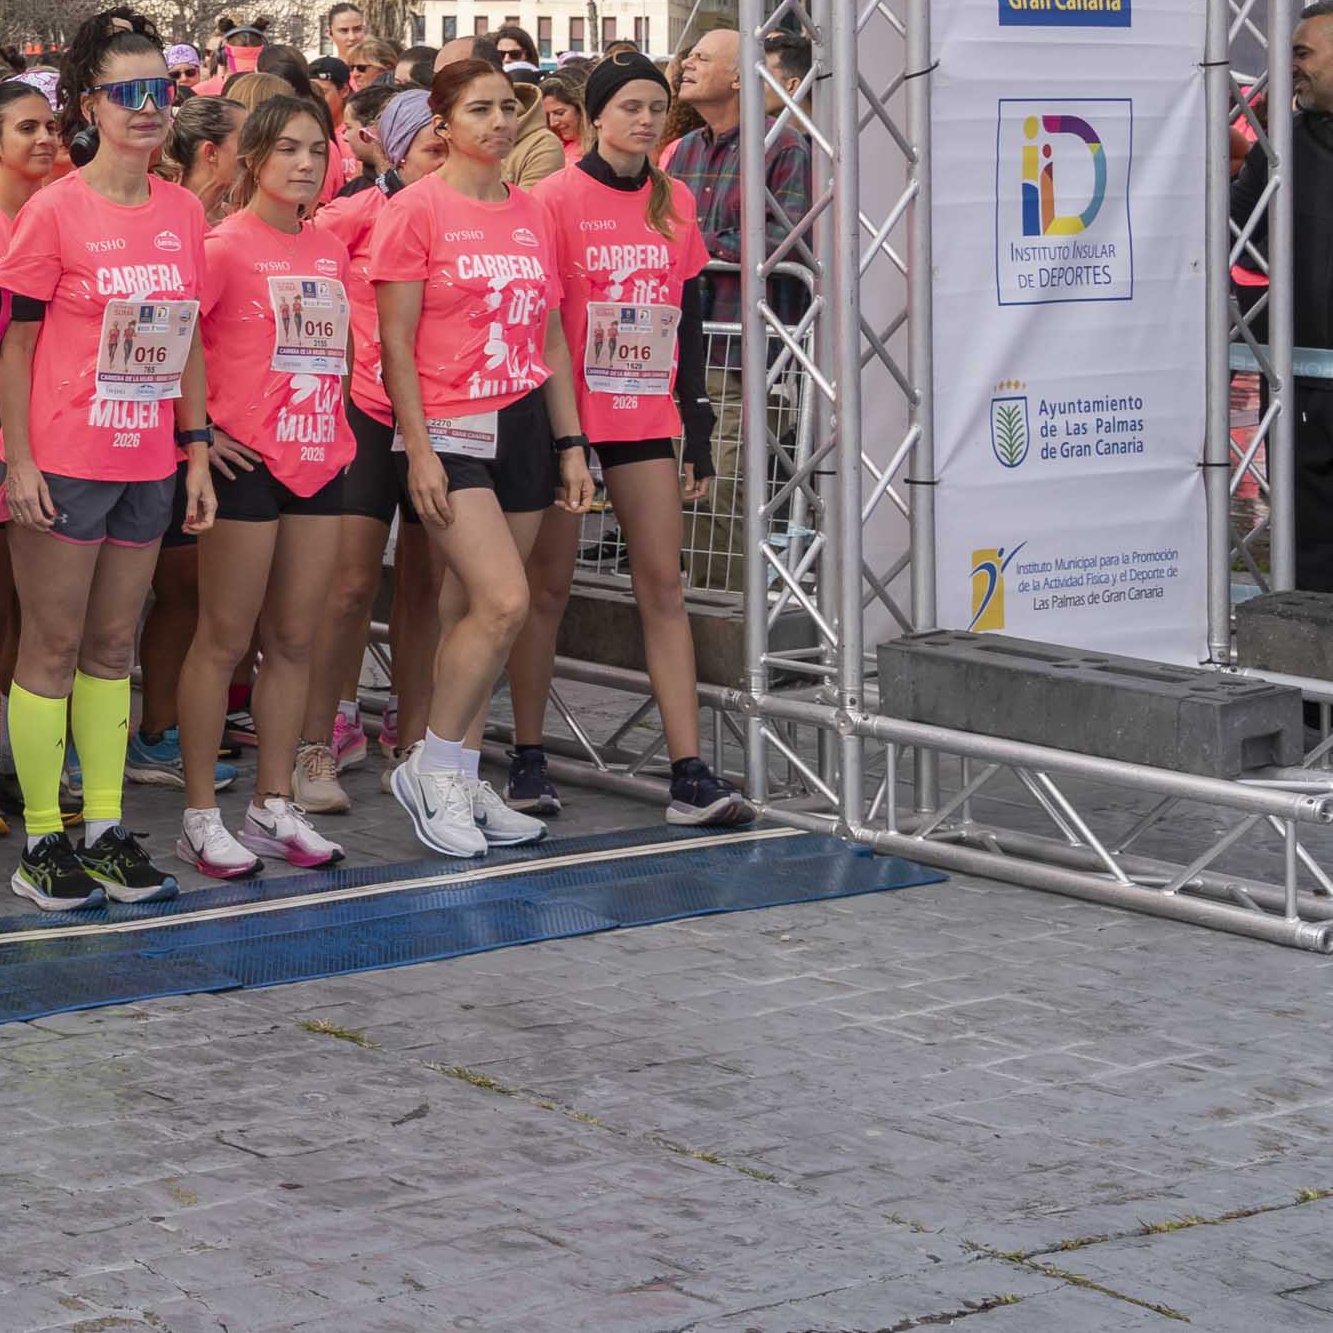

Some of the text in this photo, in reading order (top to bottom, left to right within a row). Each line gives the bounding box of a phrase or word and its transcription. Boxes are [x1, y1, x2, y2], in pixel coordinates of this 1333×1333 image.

[444, 231, 484, 243] OYSHO
[587, 245, 670, 272] CARRERA
[1011, 242, 1115, 262] INSTITUTO INSULAR
[458, 254, 545, 281] CARRERA
[1018, 266, 1111, 288] DE DEPORTES
[97, 264, 183, 296] CARRERA
[305, 321, 333, 337] 016
[135, 347, 167, 363] 016
[619, 345, 651, 359] 016
[613, 396, 638, 409] 2026
[1039, 395, 1142, 420] Ayuntamiento
[89, 401, 159, 430] MUJER
[1040, 417, 1143, 438] de Las Palmas
[113, 432, 140, 447] 2026
[1041, 437, 1143, 459] de Gran Canaria
[300, 446, 325, 462] 2026
[1016, 548, 1178, 574] Instituto Municipal para la Promoción
[1018, 579, 1030, 592] de
[1033, 578, 1041, 591] la
[1043, 573, 1083, 590] Actividad
[1112, 573, 1118, 586] y
[1120, 568, 1127, 582] el
[1130, 568, 1165, 584] Deporte
[1168, 566, 1178, 578] de
[1033, 586, 1163, 610] Las Palmas de Gran Canaria
